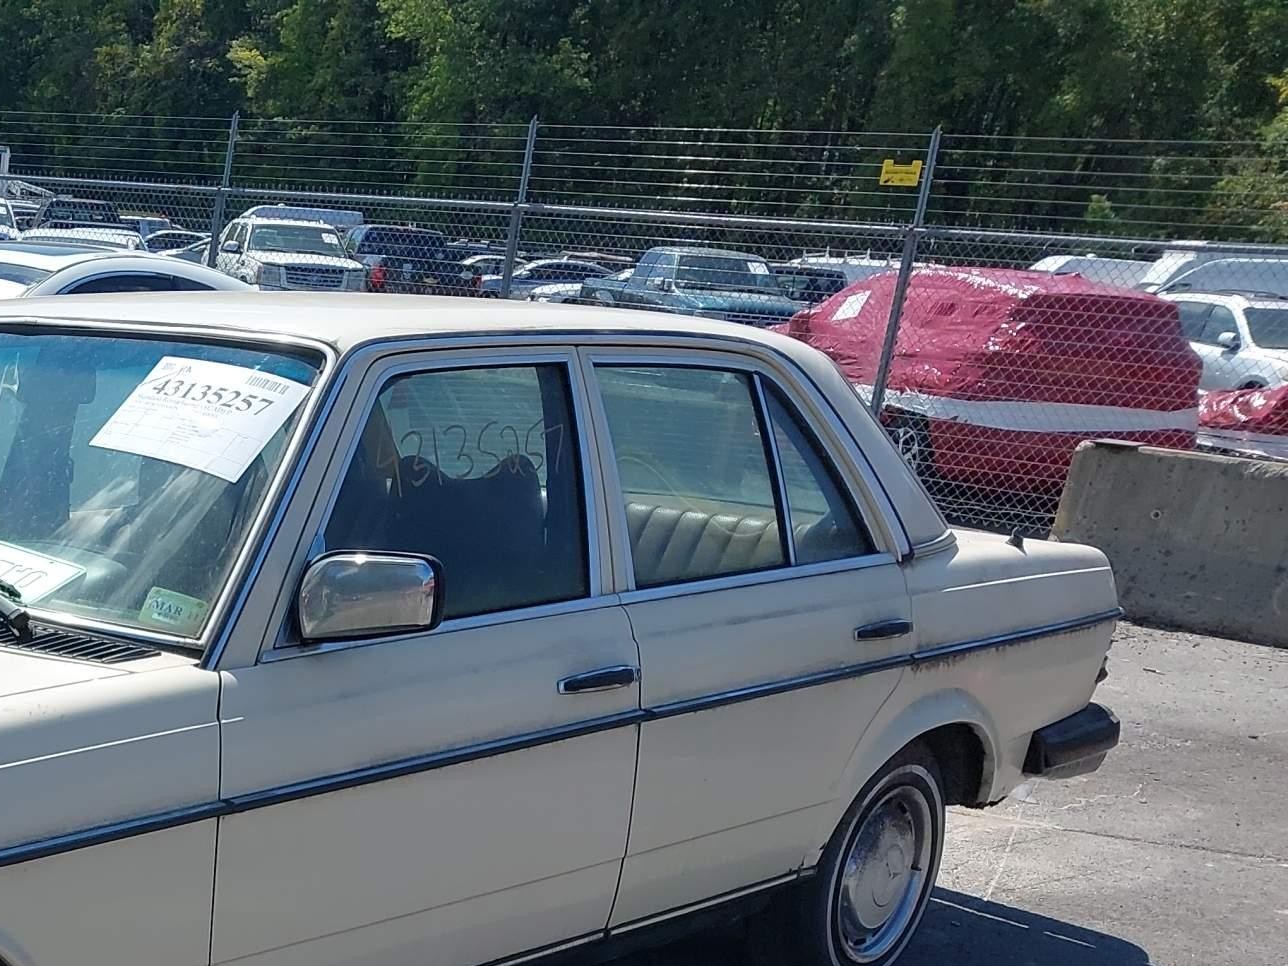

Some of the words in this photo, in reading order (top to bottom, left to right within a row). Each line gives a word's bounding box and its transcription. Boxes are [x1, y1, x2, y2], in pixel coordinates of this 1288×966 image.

[152, 377, 275, 416] 43135257
[376, 418, 564, 498] 43135257
[152, 599, 184, 617] MAR
